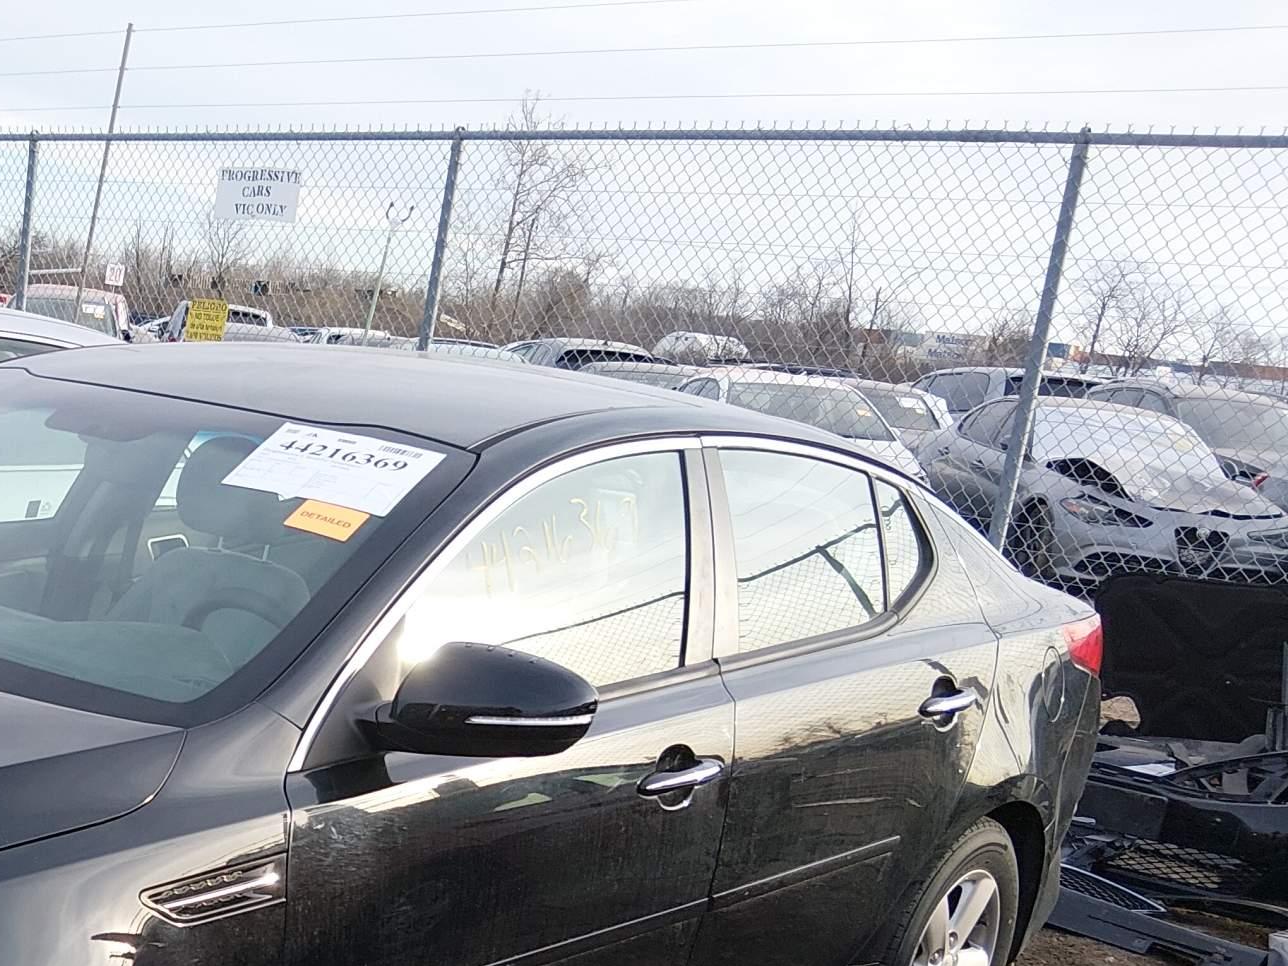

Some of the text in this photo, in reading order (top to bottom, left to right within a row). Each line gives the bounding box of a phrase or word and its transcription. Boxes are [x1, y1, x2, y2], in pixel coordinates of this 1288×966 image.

[221, 169, 301, 184] PROGRESSIVE
[242, 185, 271, 198] CARS
[256, 203, 287, 216] ONLY
[279, 439, 408, 472] 44216369
[300, 510, 352, 529] DETAILED
